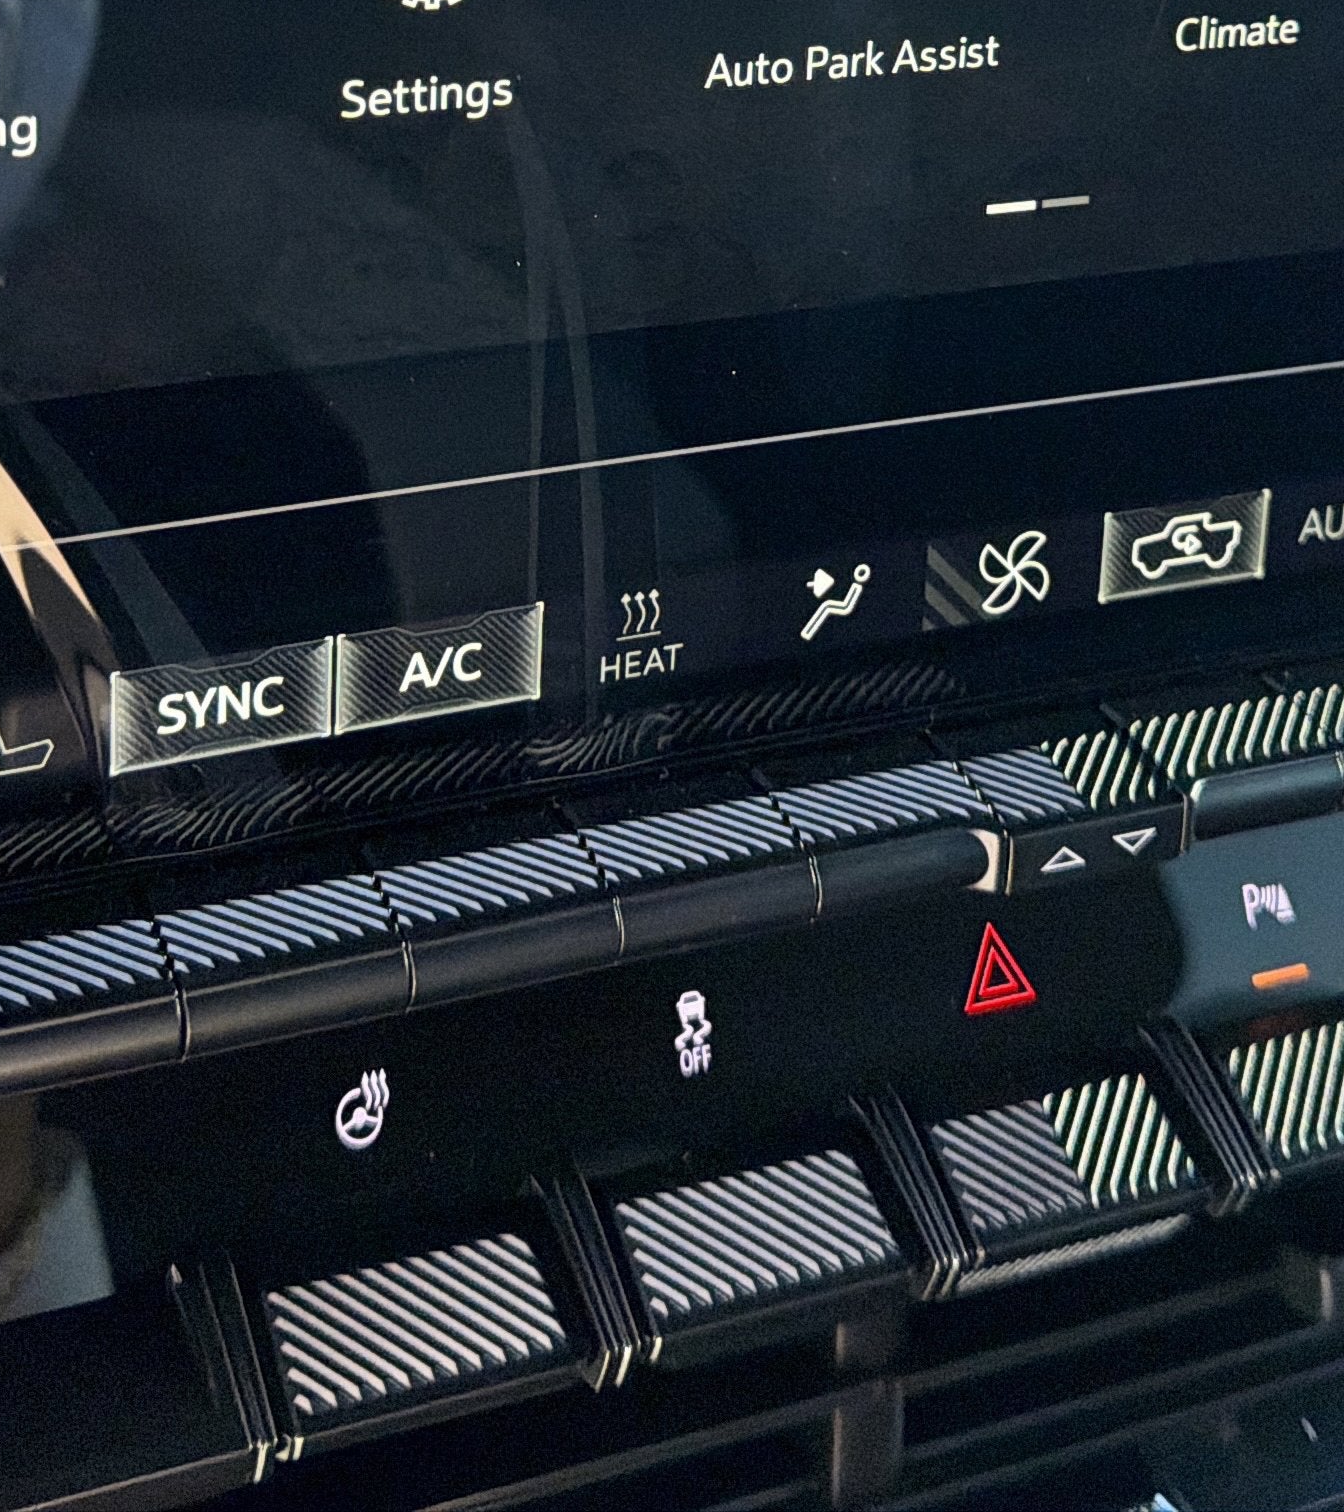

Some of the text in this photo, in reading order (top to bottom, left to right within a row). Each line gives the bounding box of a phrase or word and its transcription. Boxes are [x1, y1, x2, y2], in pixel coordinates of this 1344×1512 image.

[1175, 14, 1300, 52] Climate
[704, 35, 1000, 89] Auto Park Assist
[340, 75, 513, 120] Settings
[399, 642, 482, 693] A/C
[599, 642, 684, 683] HEAT
[156, 675, 286, 735] SYNC
[678, 1044, 713, 1079] OFF
